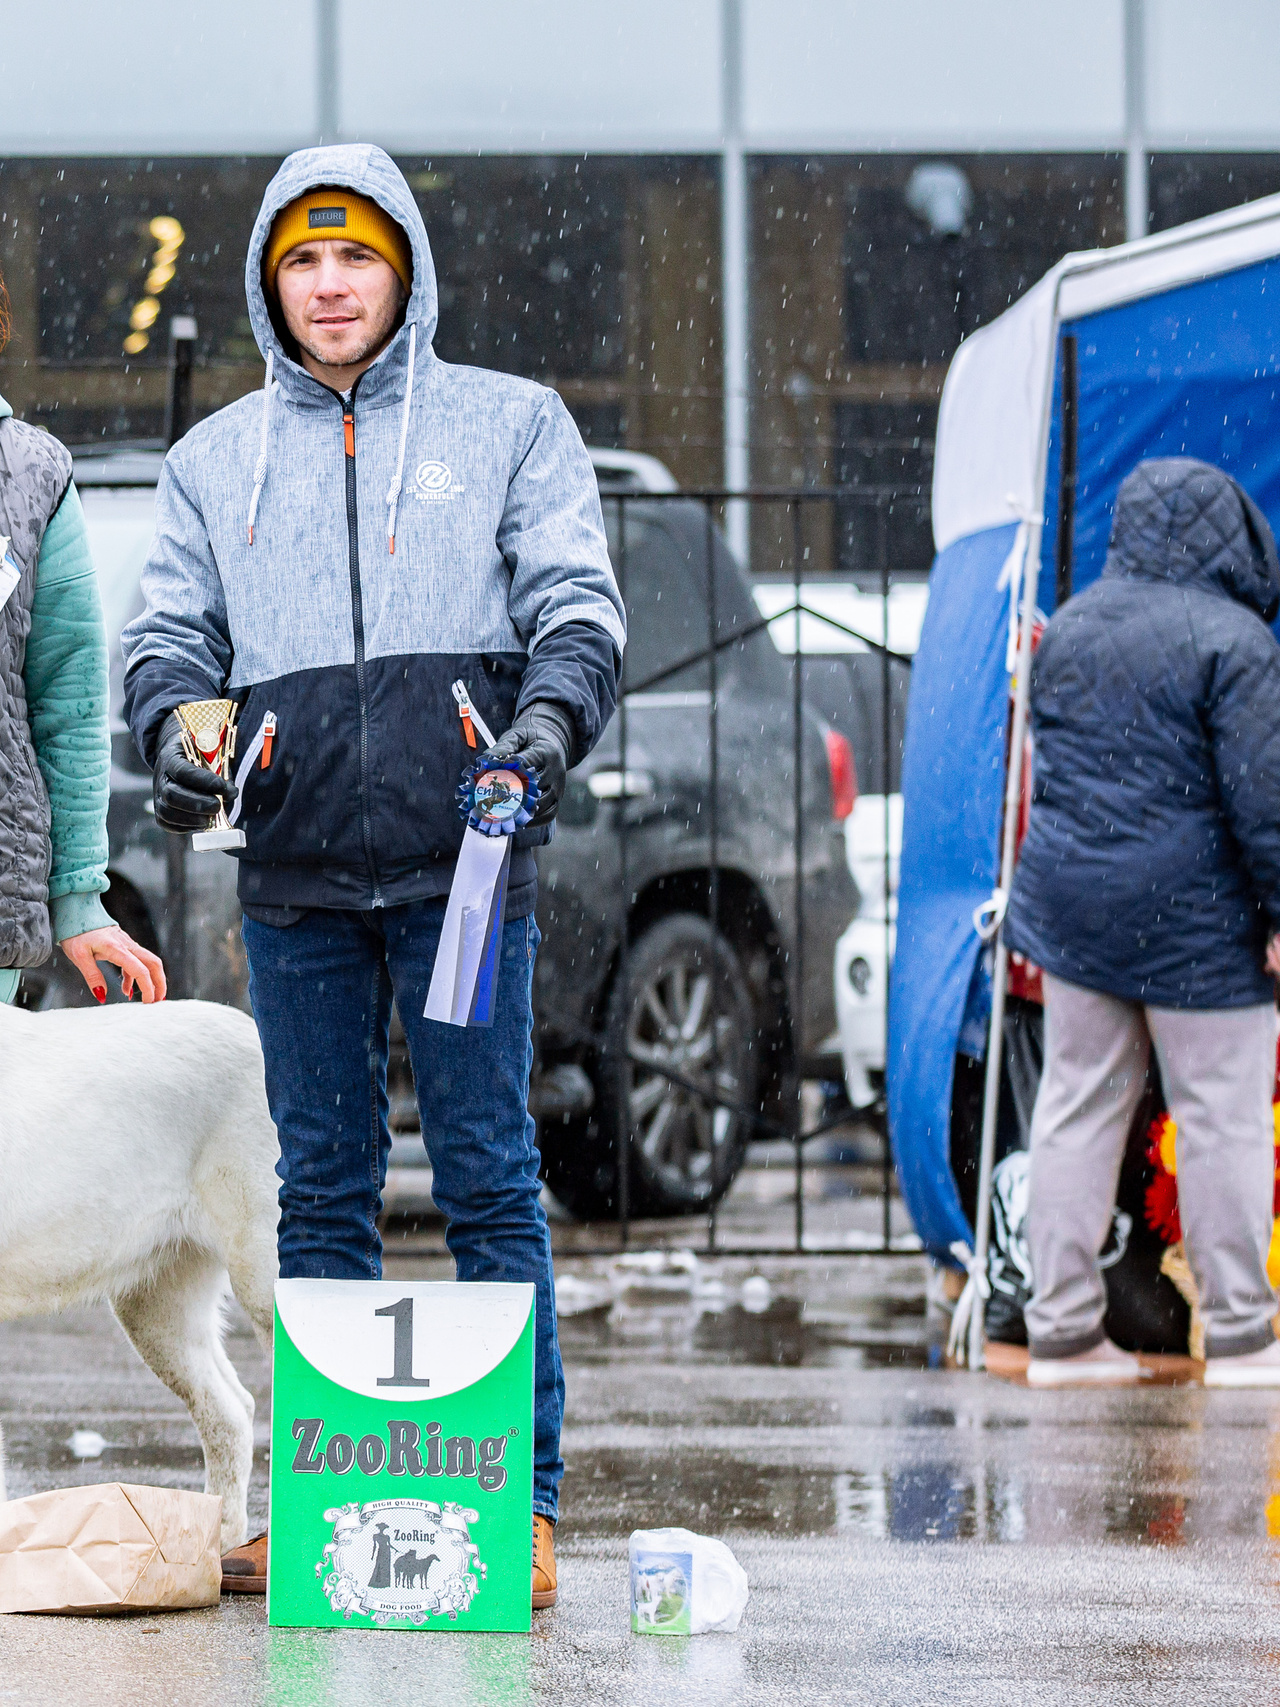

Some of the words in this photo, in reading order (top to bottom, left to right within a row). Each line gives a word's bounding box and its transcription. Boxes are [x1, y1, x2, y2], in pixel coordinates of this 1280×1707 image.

[310, 212, 344, 221] FUTURE
[375, 1297, 430, 1388] 1
[372, 1501, 392, 1509] HIGH
[394, 1500, 429, 1509] QUALITY
[380, 1603, 398, 1611] DOG
[400, 1603, 422, 1611] FOOD
